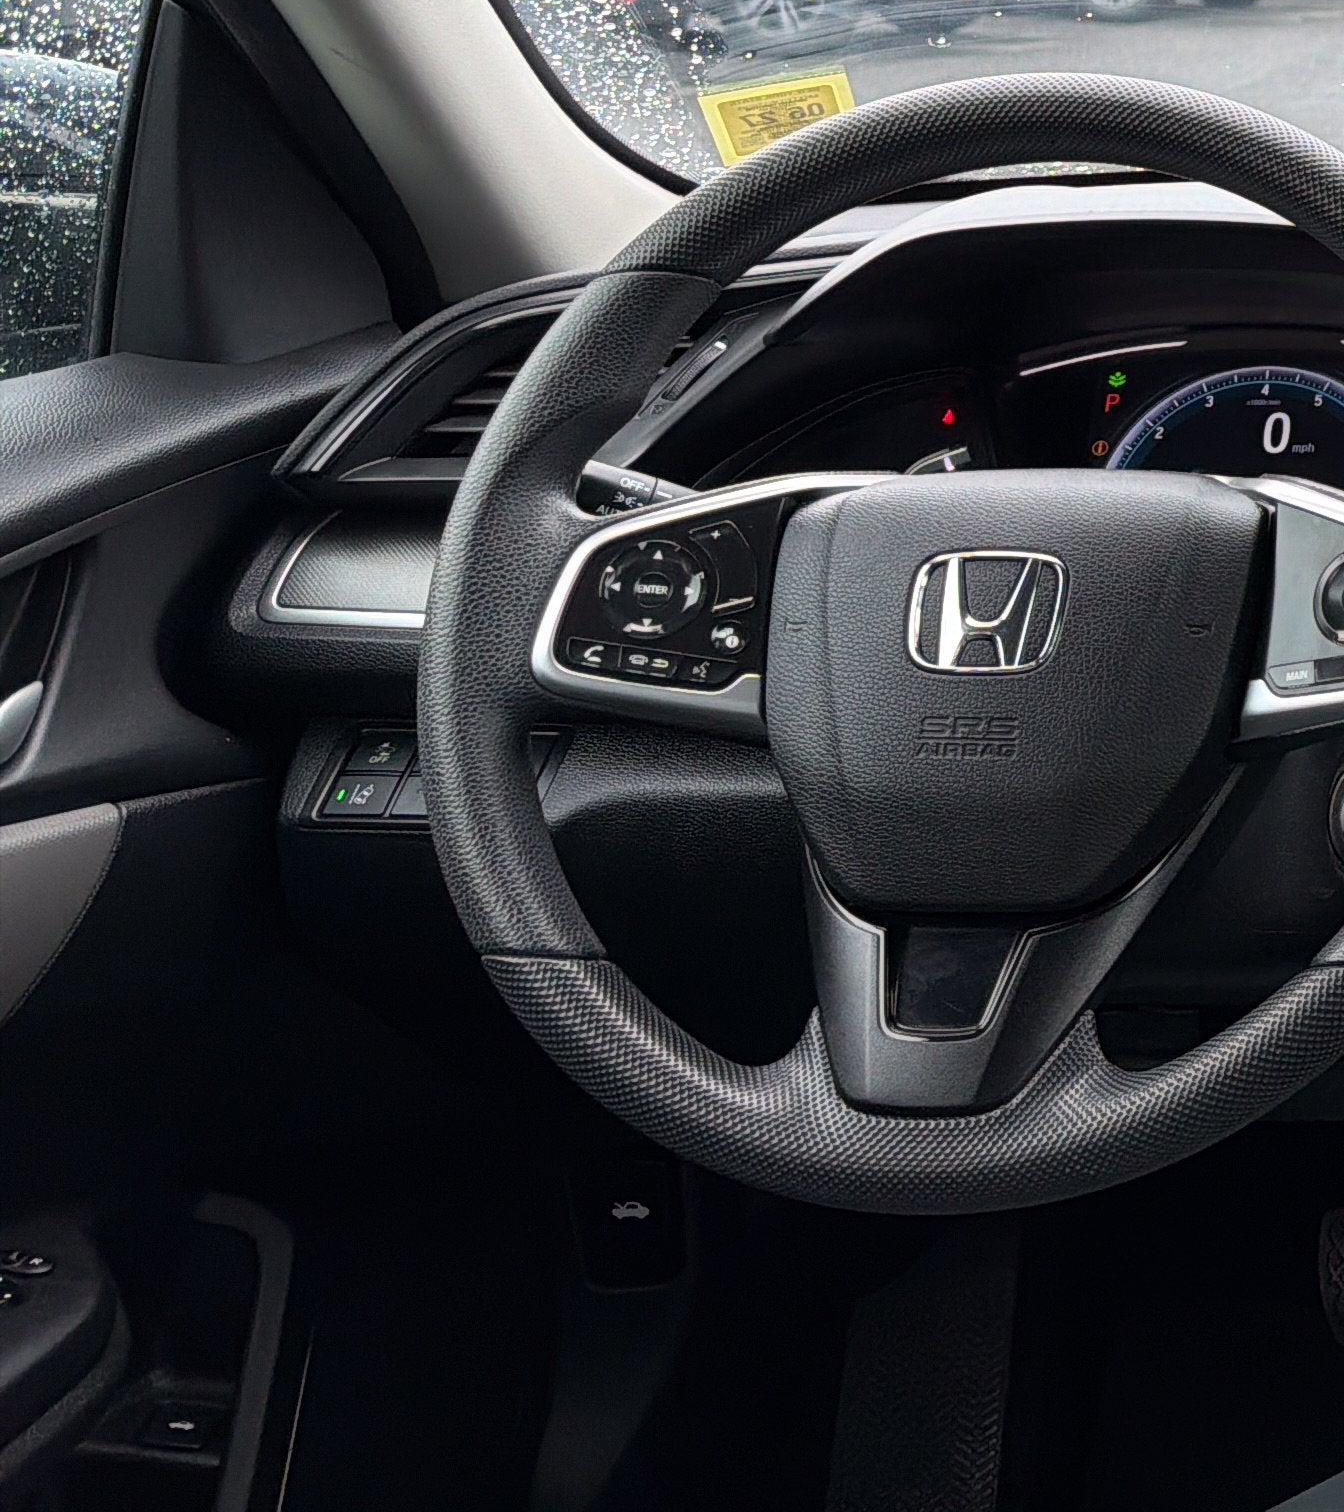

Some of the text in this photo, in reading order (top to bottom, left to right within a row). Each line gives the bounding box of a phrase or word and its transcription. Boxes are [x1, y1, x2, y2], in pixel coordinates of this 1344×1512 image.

[1261, 383, 1270, 396] 4
[1104, 394, 1121, 413] P
[1204, 395, 1214, 407] 3
[1314, 394, 1323, 407] 5
[1154, 427, 1165, 439] 2
[1263, 412, 1315, 454] 0 mph
[620, 477, 645, 491] OFF
[637, 584, 668, 595] ENTER
[1286, 670, 1308, 682] MAIN
[920, 716, 1018, 737] SRS
[916, 741, 1018, 759] AIRBAG
[368, 755, 390, 764] OFF
